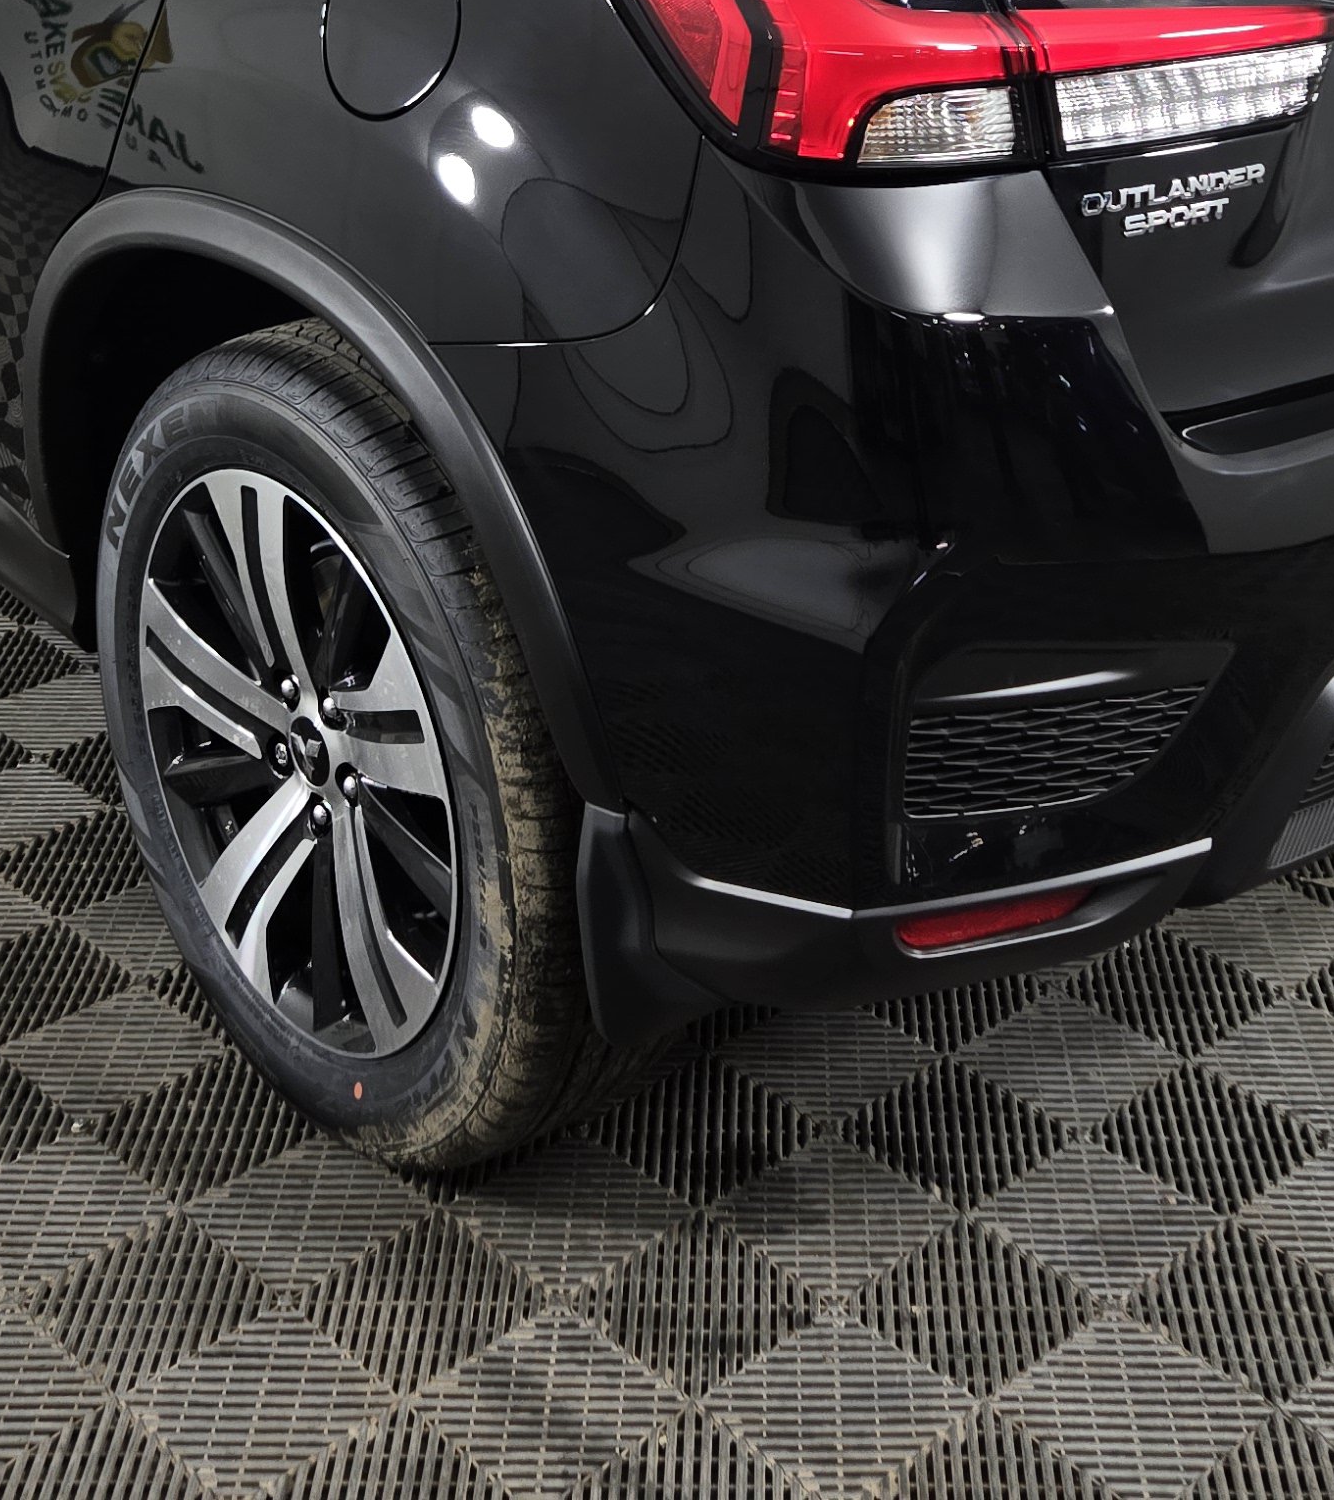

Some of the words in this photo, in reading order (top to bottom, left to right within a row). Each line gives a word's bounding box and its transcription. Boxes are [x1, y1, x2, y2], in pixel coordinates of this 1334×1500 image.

[1081, 163, 1265, 217] OUTLANDER
[1123, 198, 1229, 237] SPORT
[105, 397, 217, 550] NEXEN
